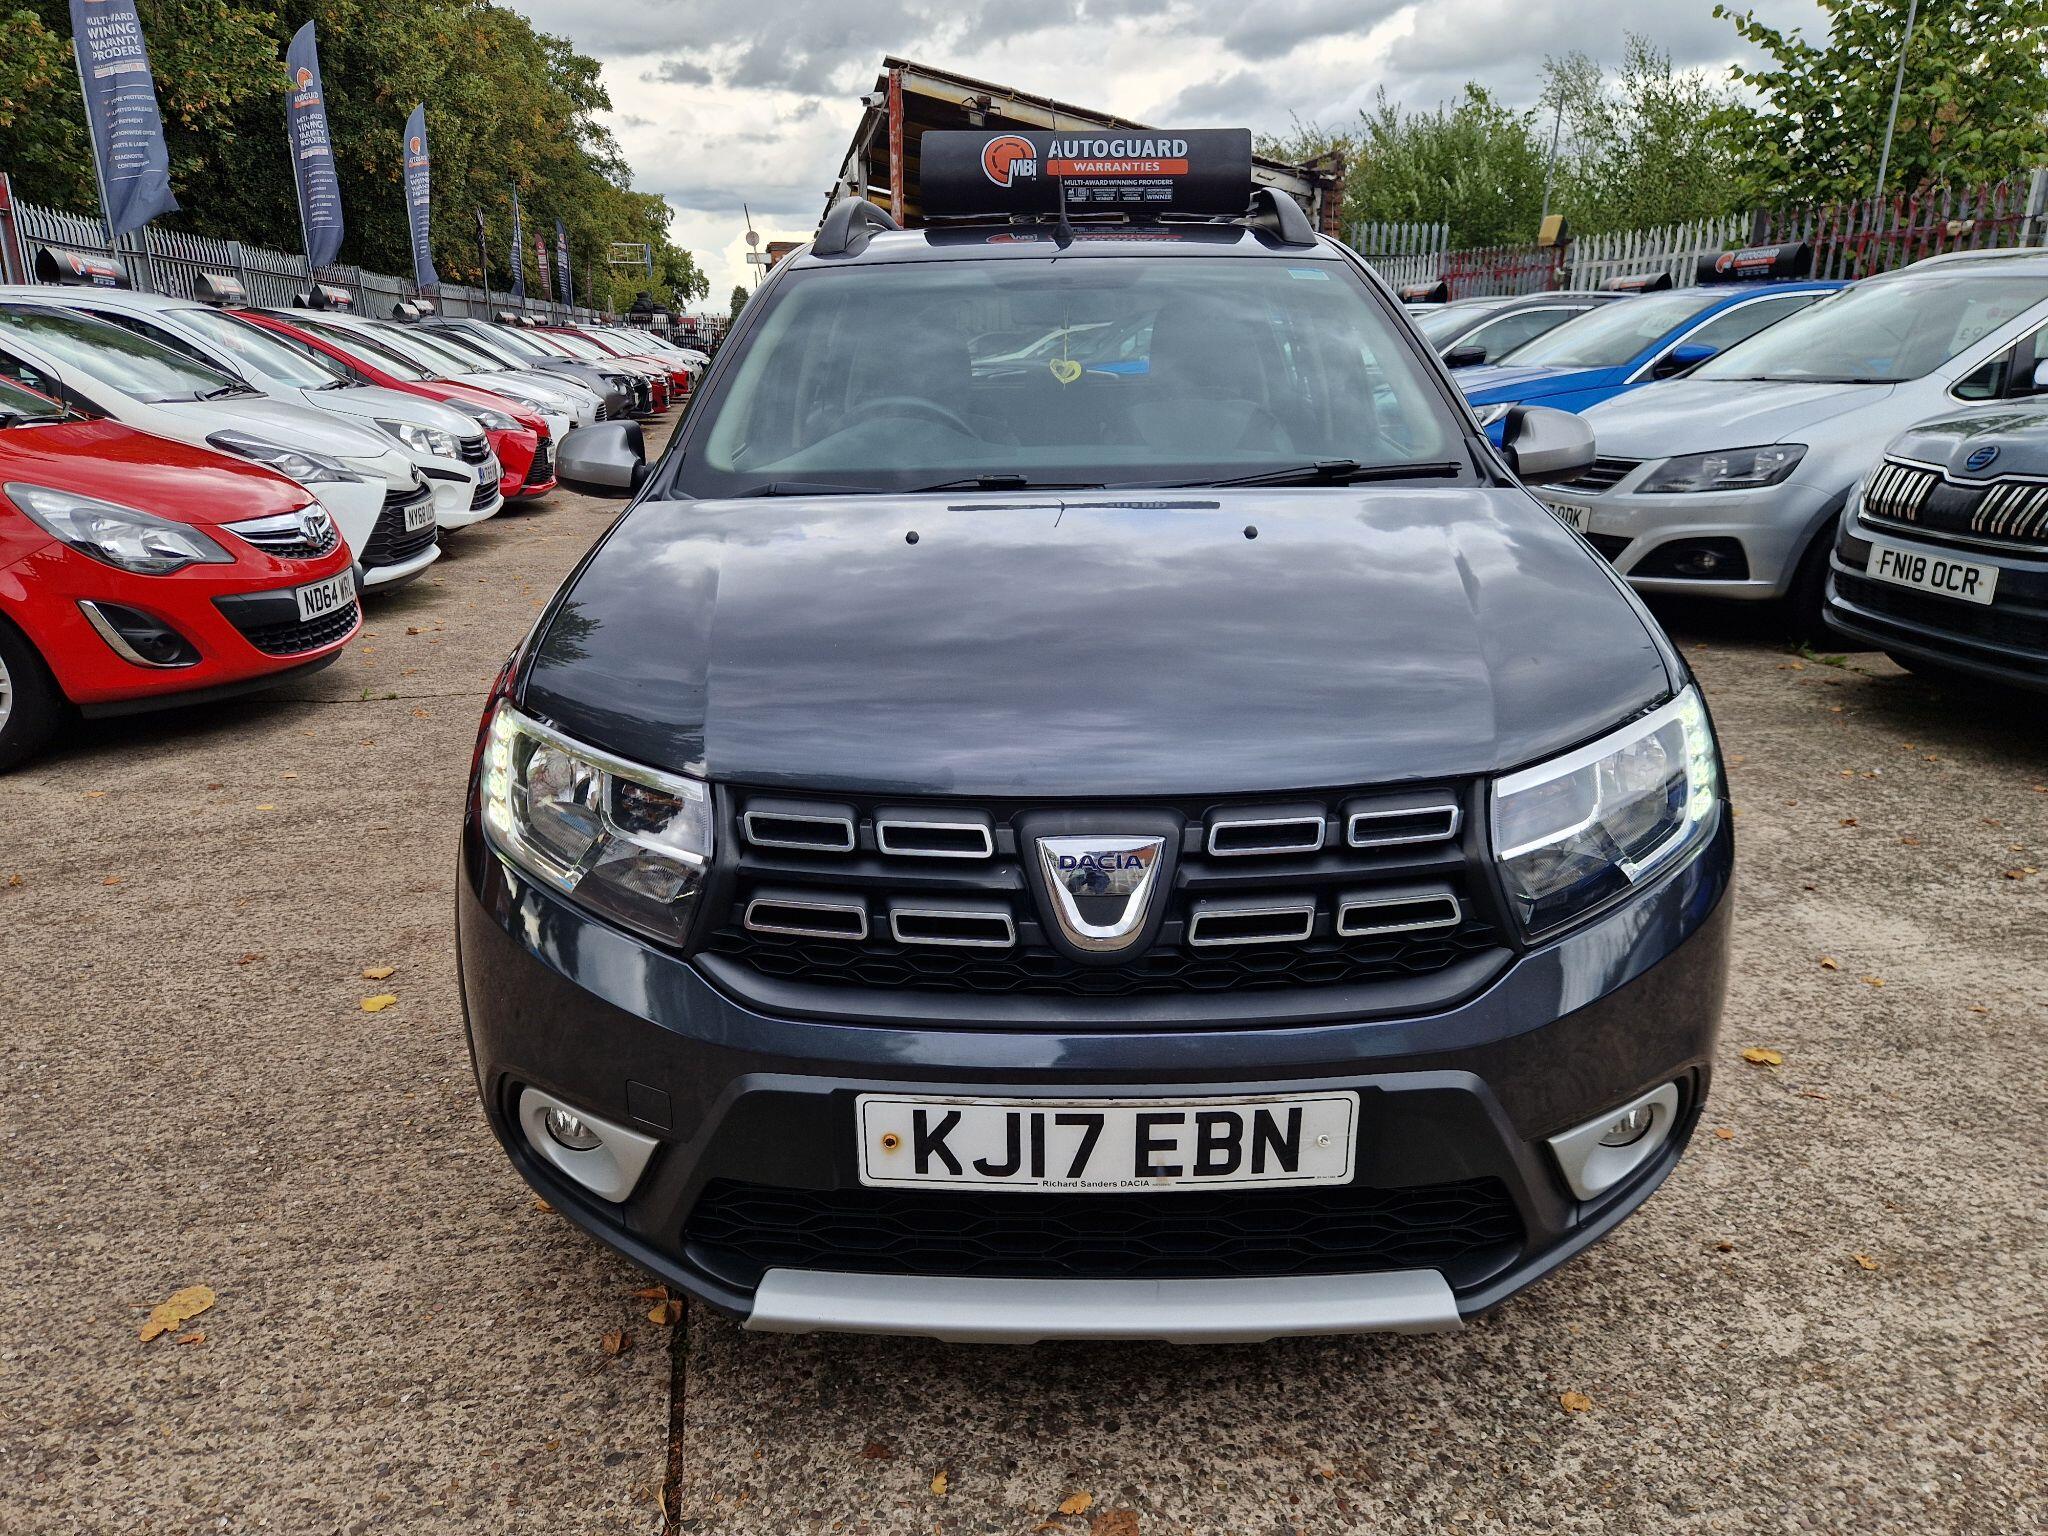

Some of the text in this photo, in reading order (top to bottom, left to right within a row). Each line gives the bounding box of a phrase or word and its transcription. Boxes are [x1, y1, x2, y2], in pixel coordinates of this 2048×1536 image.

[1047, 139, 1188, 159] AUTOGUARD
[1073, 162, 1160, 173] WARRANTIES
[1880, 549, 1980, 595] FN18 OCR
[304, 581, 338, 615] ND64
[1059, 855, 1144, 870] DACIA
[911, 1107, 1303, 1179] KJ17 EBN
[1042, 1180, 1078, 1188] Richard
[1080, 1180, 1118, 1188] Sanders
[1120, 1179, 1150, 1187] DACIA
